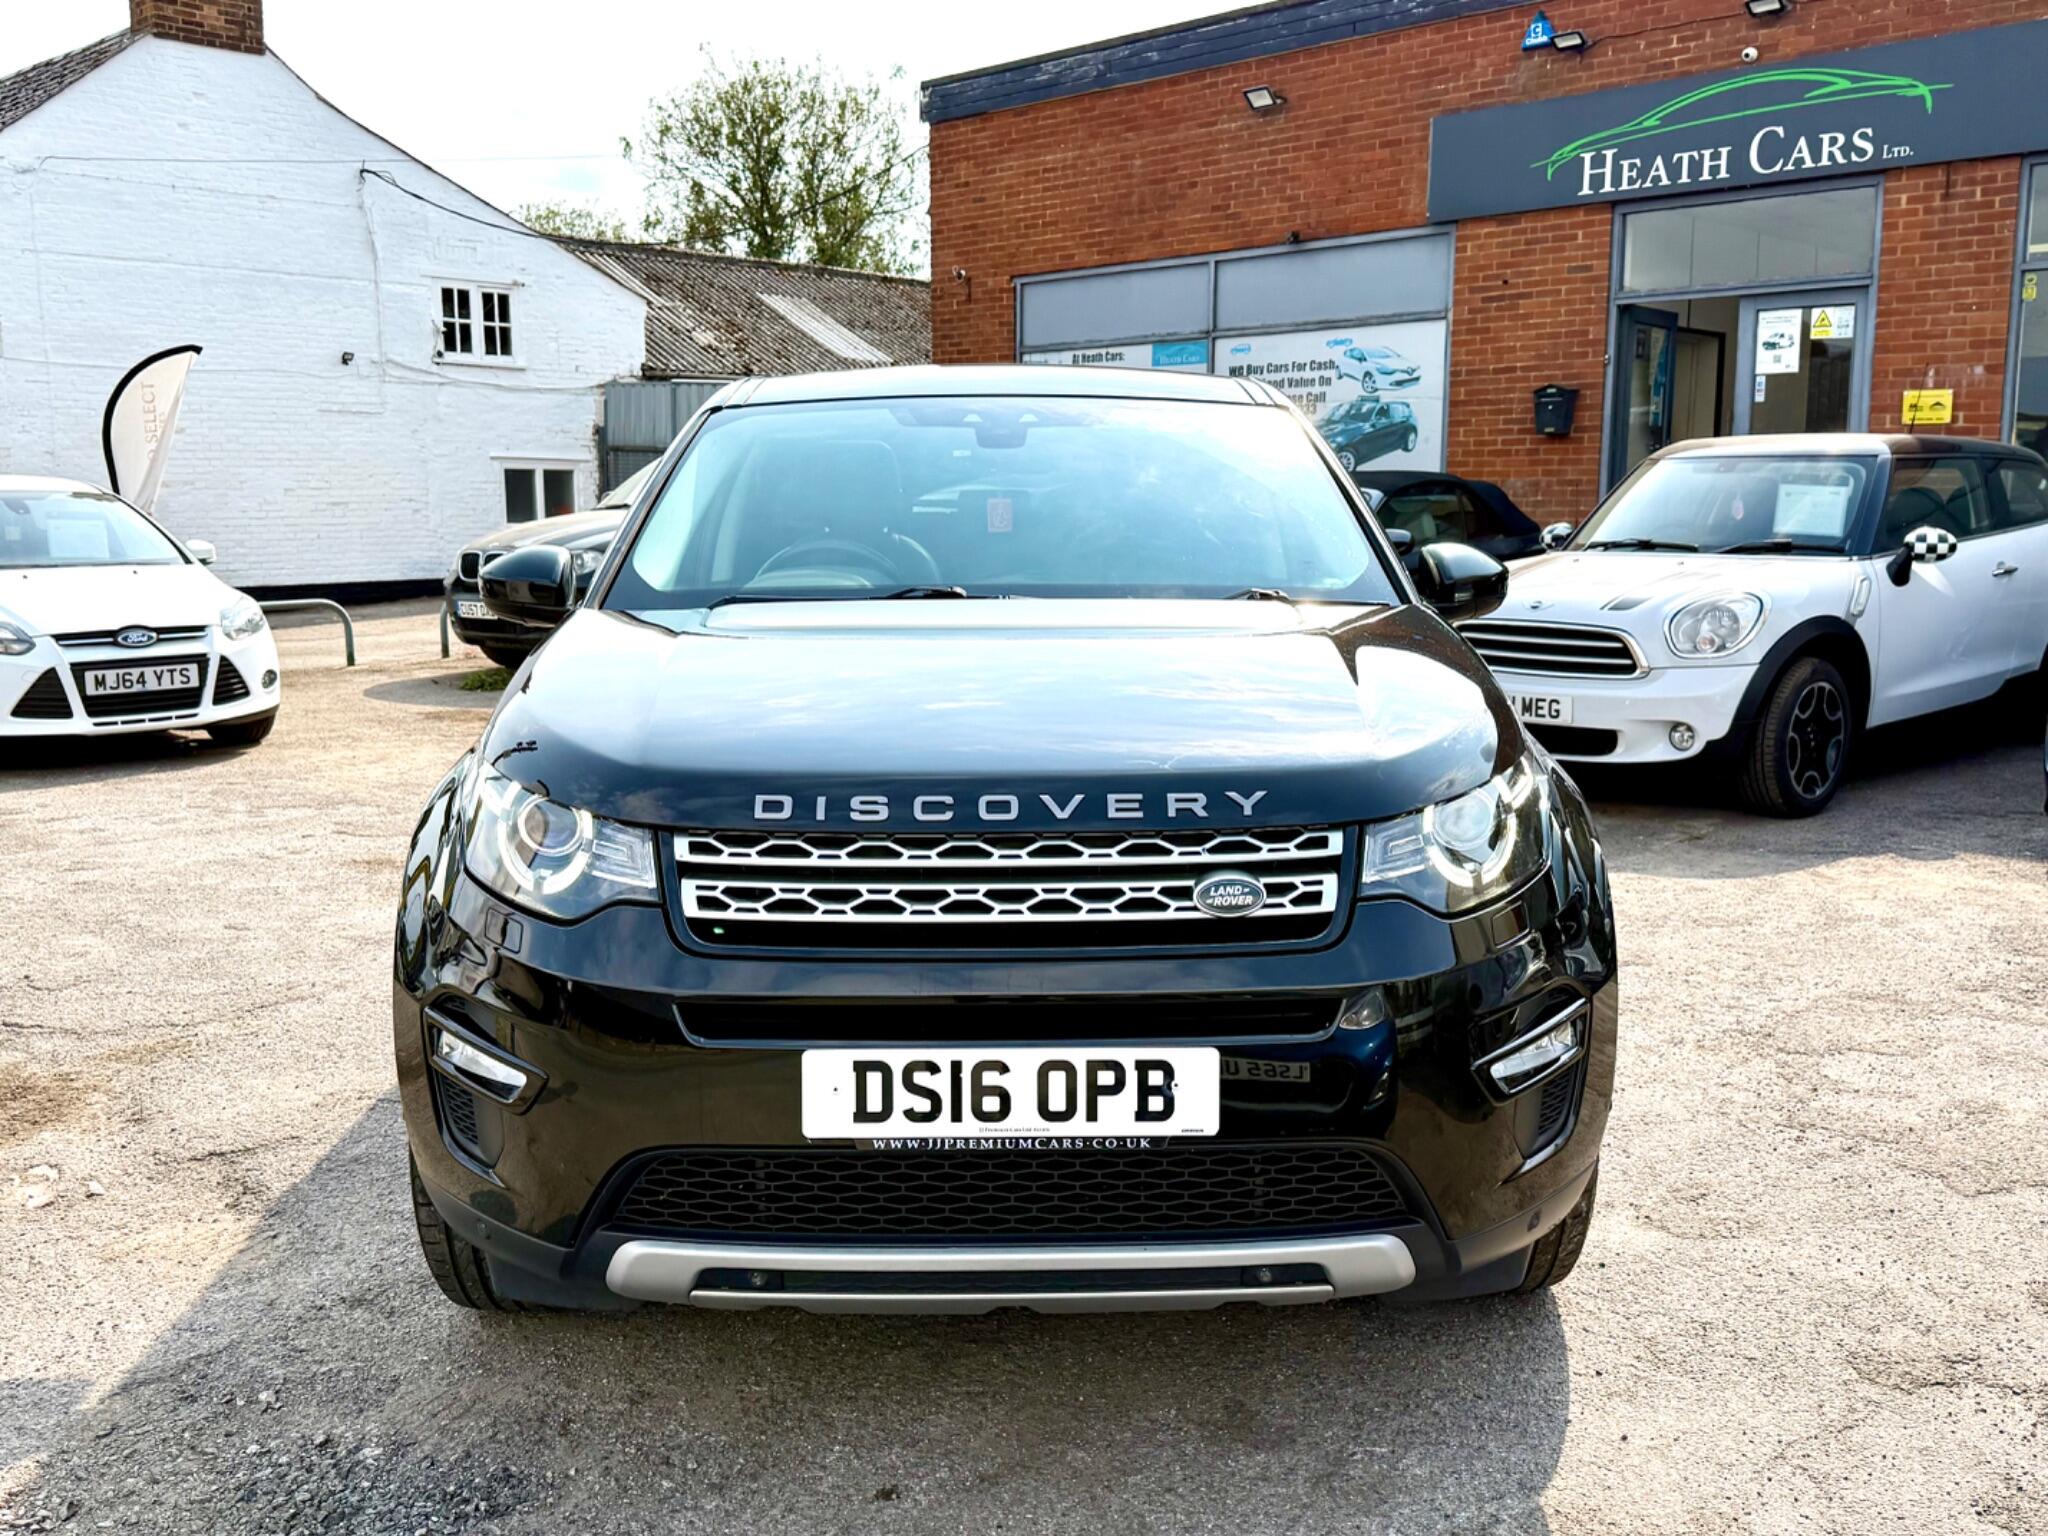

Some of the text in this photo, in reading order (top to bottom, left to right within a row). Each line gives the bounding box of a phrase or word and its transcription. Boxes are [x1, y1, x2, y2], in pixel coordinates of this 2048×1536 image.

[1577, 146, 1732, 196] HEATH
[1750, 125, 1874, 175] CARS
[1246, 364, 1264, 376] Buy
[1266, 362, 1290, 374] Cars
[1291, 361, 1308, 372] For
[1287, 376, 1315, 388] Value
[1318, 375, 1332, 387] On
[1306, 391, 1326, 403] Call
[141, 382, 158, 444] SELECT
[126, 632, 149, 644] Ford
[94, 667, 191, 691] MJ64 YTS
[1521, 696, 1561, 719] MEG
[753, 790, 1268, 821] DISCOVERY
[1210, 885, 1242, 896] LAND
[1213, 895, 1253, 906] ROVER
[853, 1060, 1176, 1124] DS16 OPB
